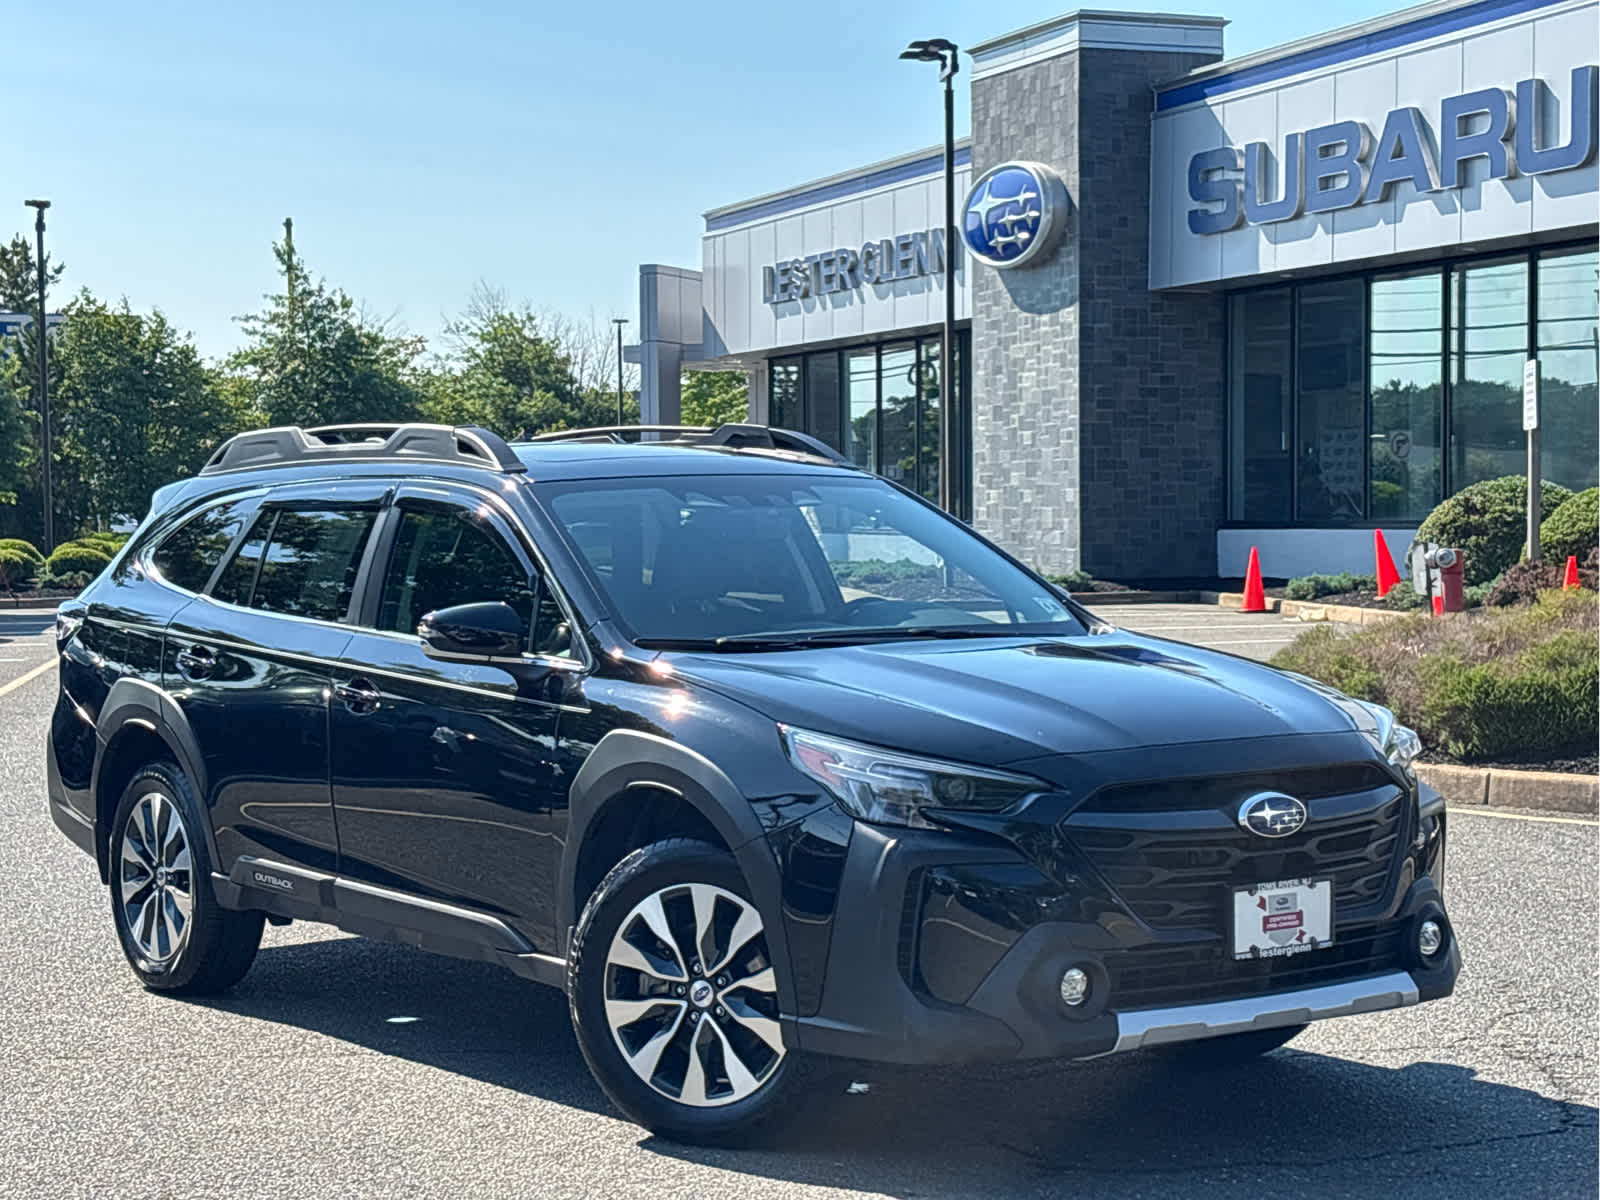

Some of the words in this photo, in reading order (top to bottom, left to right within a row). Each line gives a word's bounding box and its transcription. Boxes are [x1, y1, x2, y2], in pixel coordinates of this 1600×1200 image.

[1187, 65, 1599, 235] SUBARU
[763, 248, 861, 304] LESTER
[1259, 943, 1312, 959] lesterglenn
